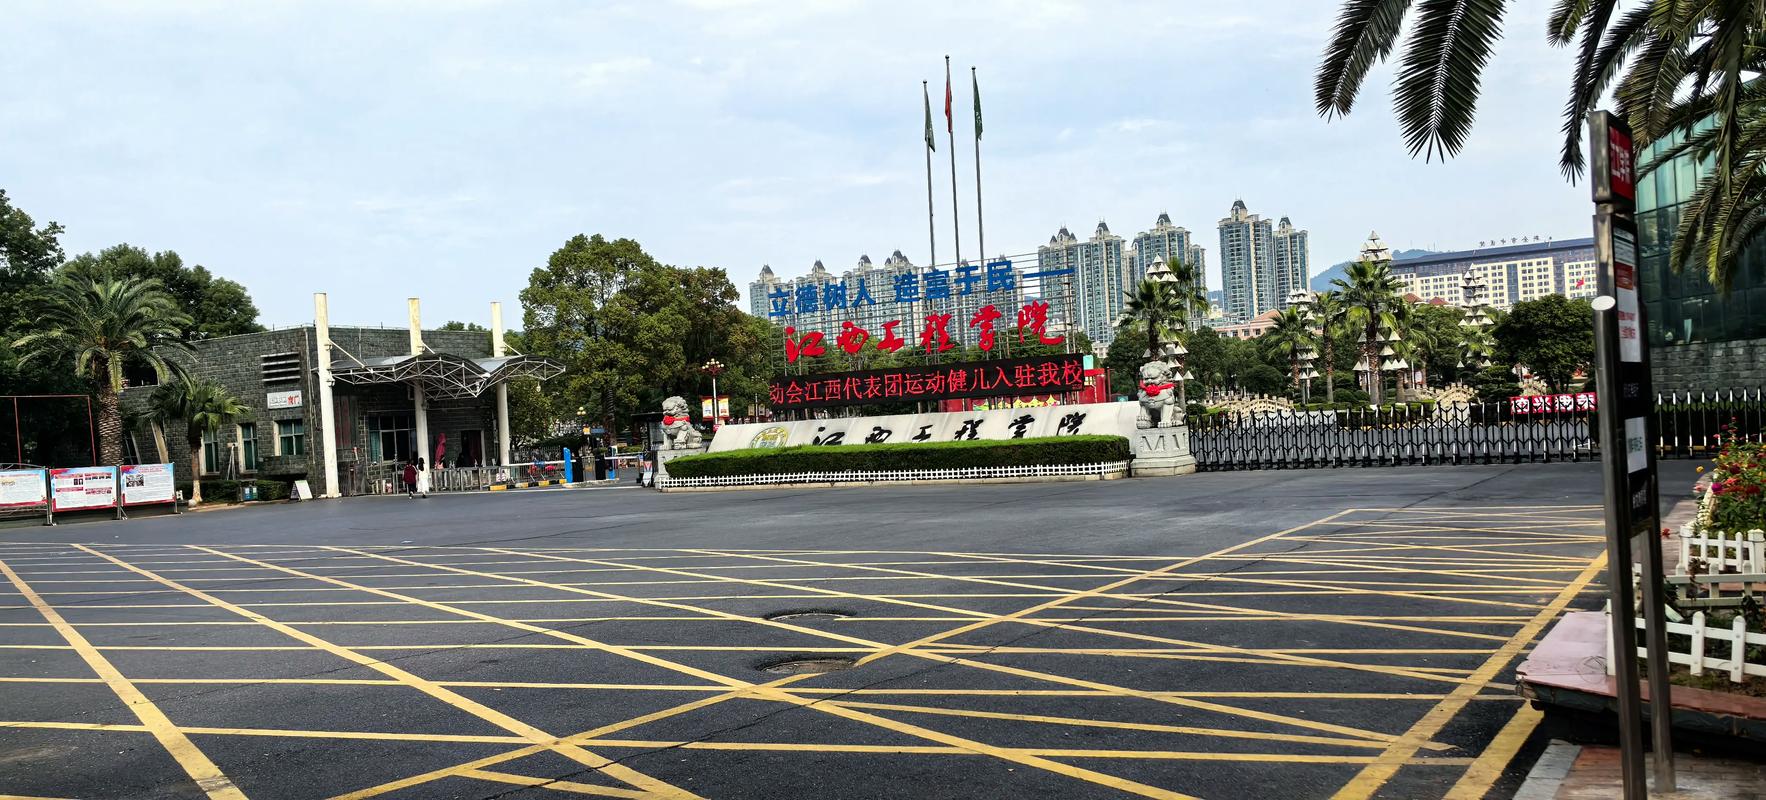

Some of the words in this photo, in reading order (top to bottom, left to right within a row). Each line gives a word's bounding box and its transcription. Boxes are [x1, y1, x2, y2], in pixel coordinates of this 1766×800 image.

[769, 279, 877, 316] 立德树人
[785, 301, 1066, 362] 江西工程学院
[769, 360, 1083, 405] 动会江西代表团运动健儿入驻我校
